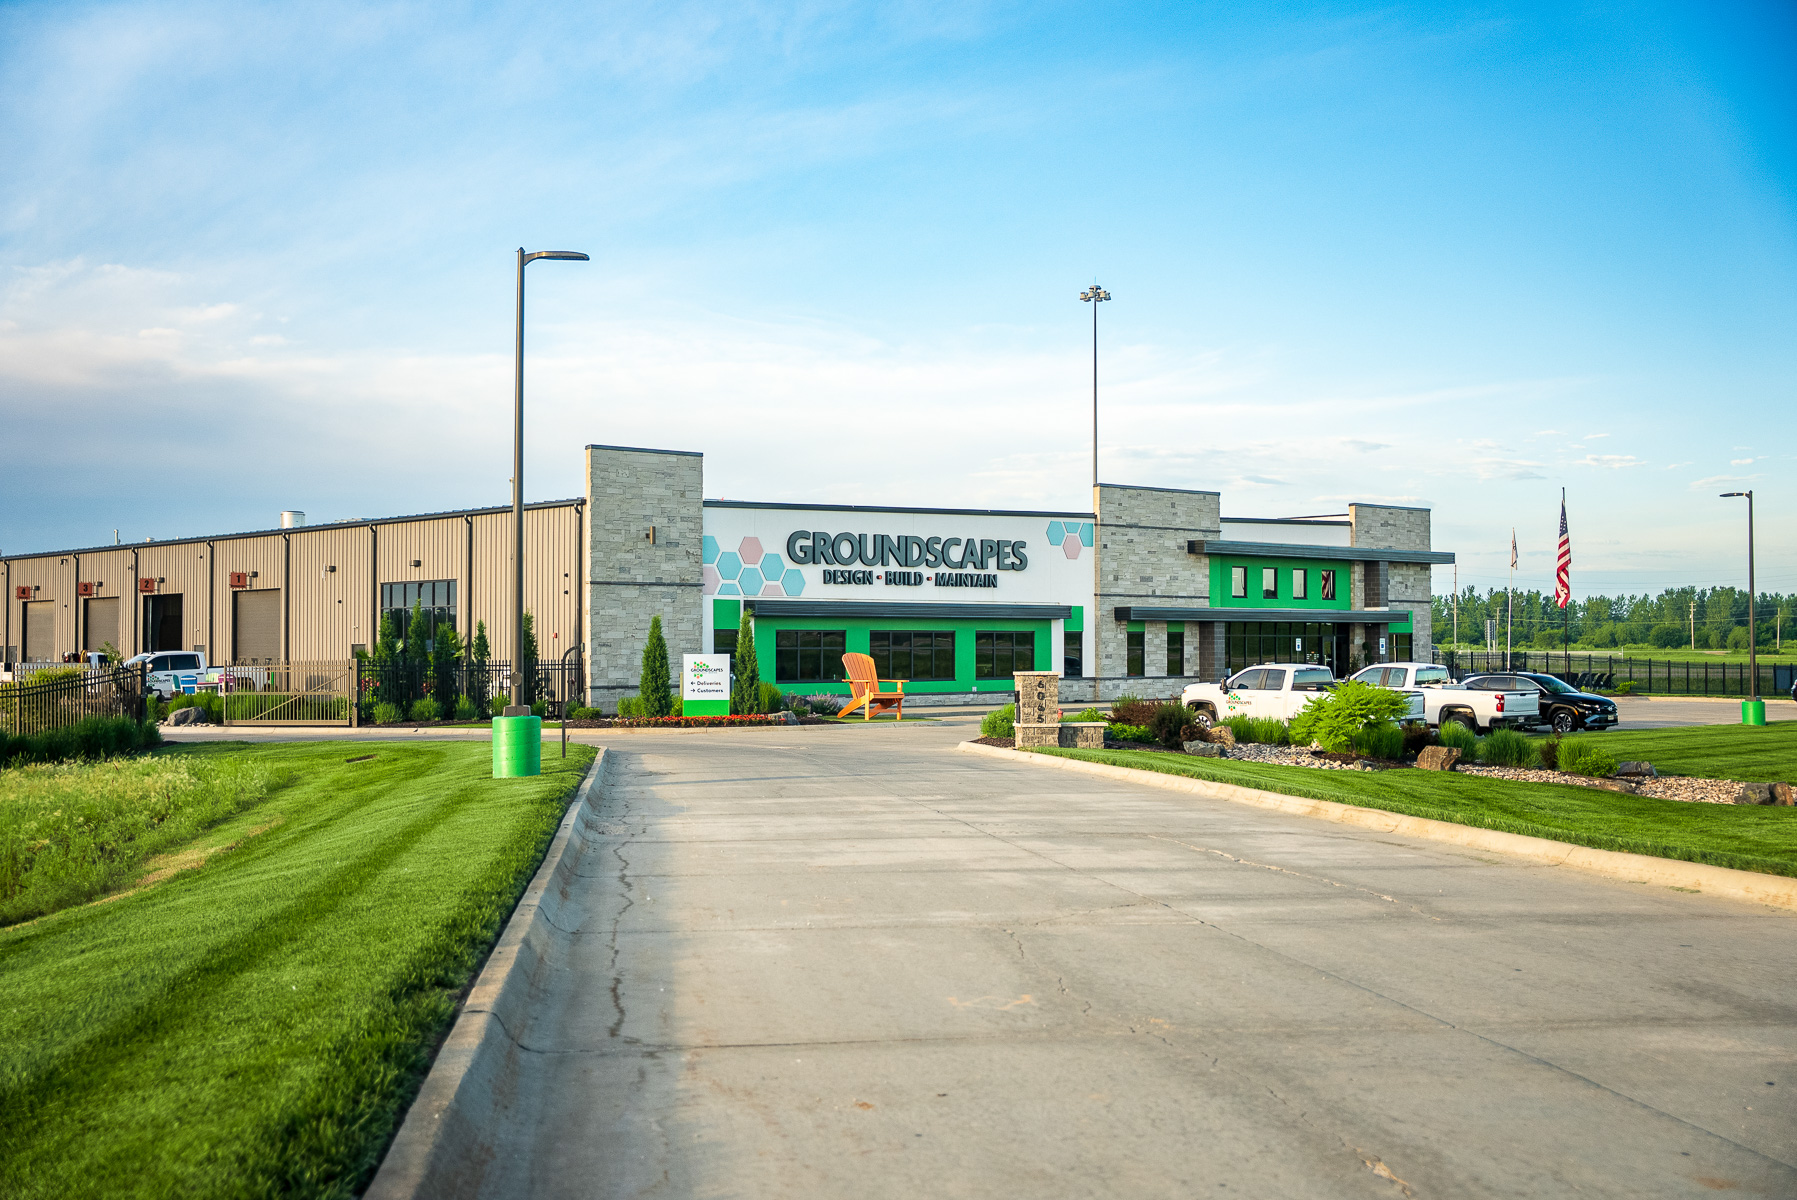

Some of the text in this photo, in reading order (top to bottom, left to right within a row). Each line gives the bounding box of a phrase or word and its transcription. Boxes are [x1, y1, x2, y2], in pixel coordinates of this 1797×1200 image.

[787, 530, 1028, 570] GROUNDSCAPES
[237, 574, 241, 583] 1
[823, 569, 998, 588] DESIGN BUILD MAINTAIN
[83, 584, 88, 592] 3
[144, 580, 149, 589] 2
[20, 588, 26, 596] 4
